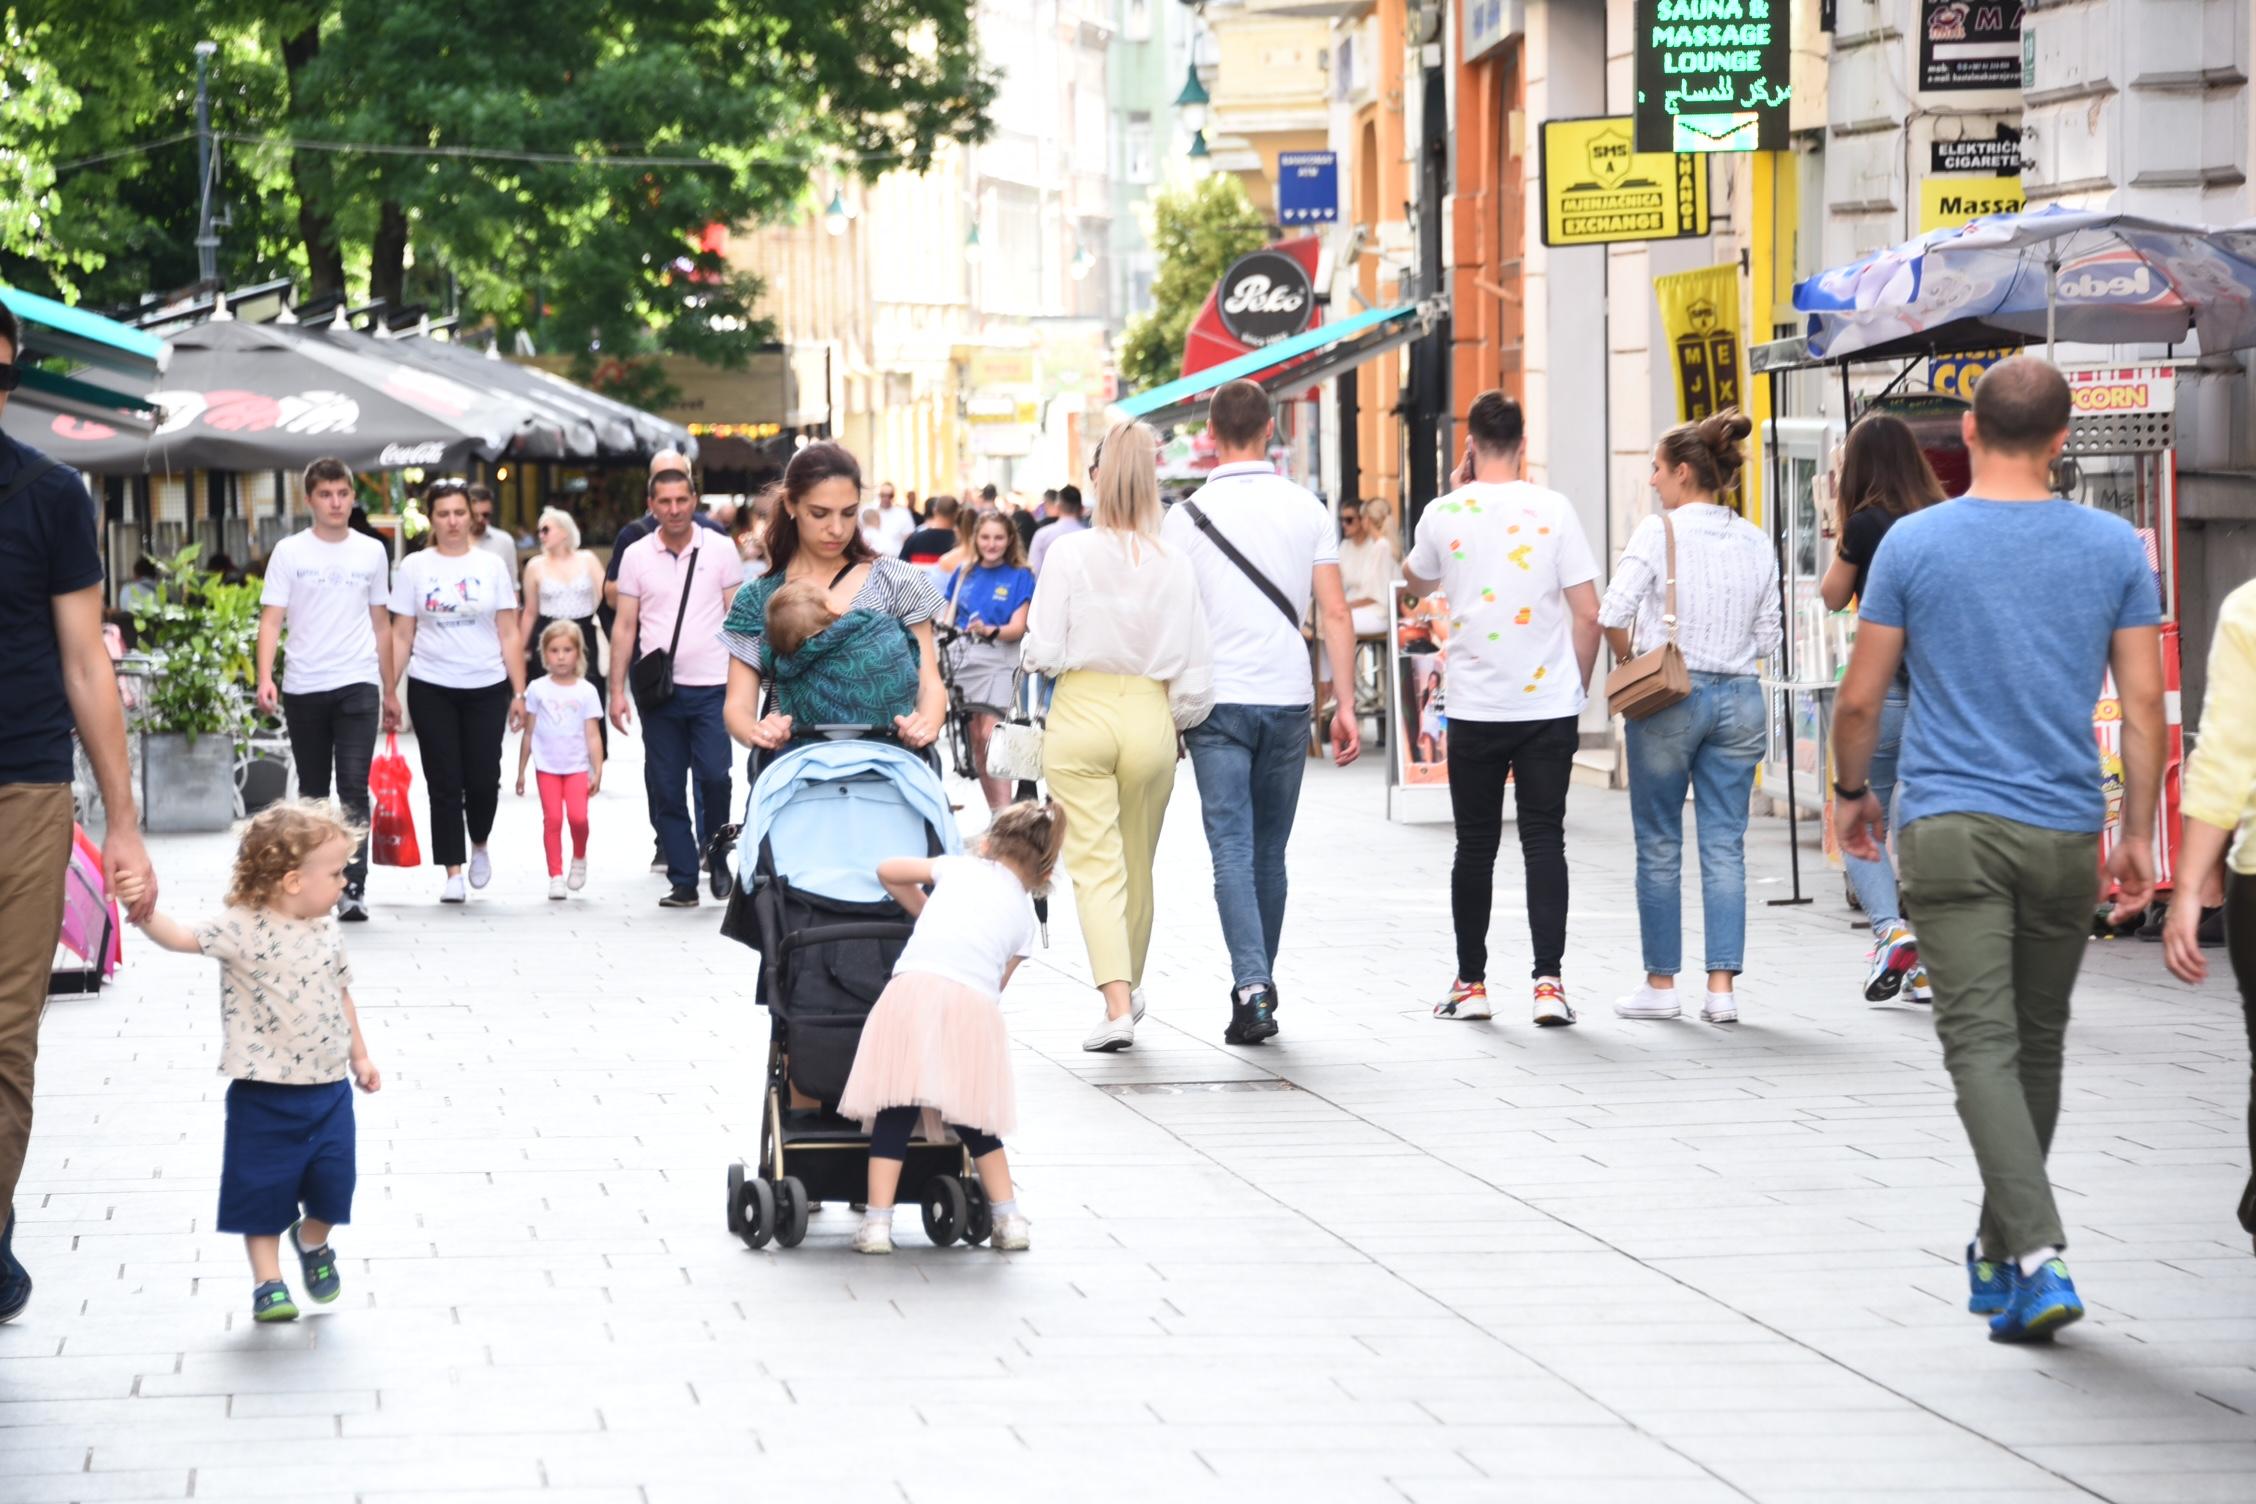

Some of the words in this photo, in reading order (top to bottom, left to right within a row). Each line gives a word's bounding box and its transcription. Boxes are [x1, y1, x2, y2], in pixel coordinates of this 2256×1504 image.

[1657, 0, 1743, 21] SAUNA
[1652, 23, 1771, 48] MASSAGE
[1664, 50, 1761, 73] LOUNGE
[1593, 145, 1627, 158] SMS
[1944, 155, 2020, 168] CIGARETE
[1606, 161, 1614, 172] A
[1940, 196, 2028, 215] Massa
[1564, 214, 1661, 236] EXCHANGE
[1224, 274, 1304, 314] Peko
